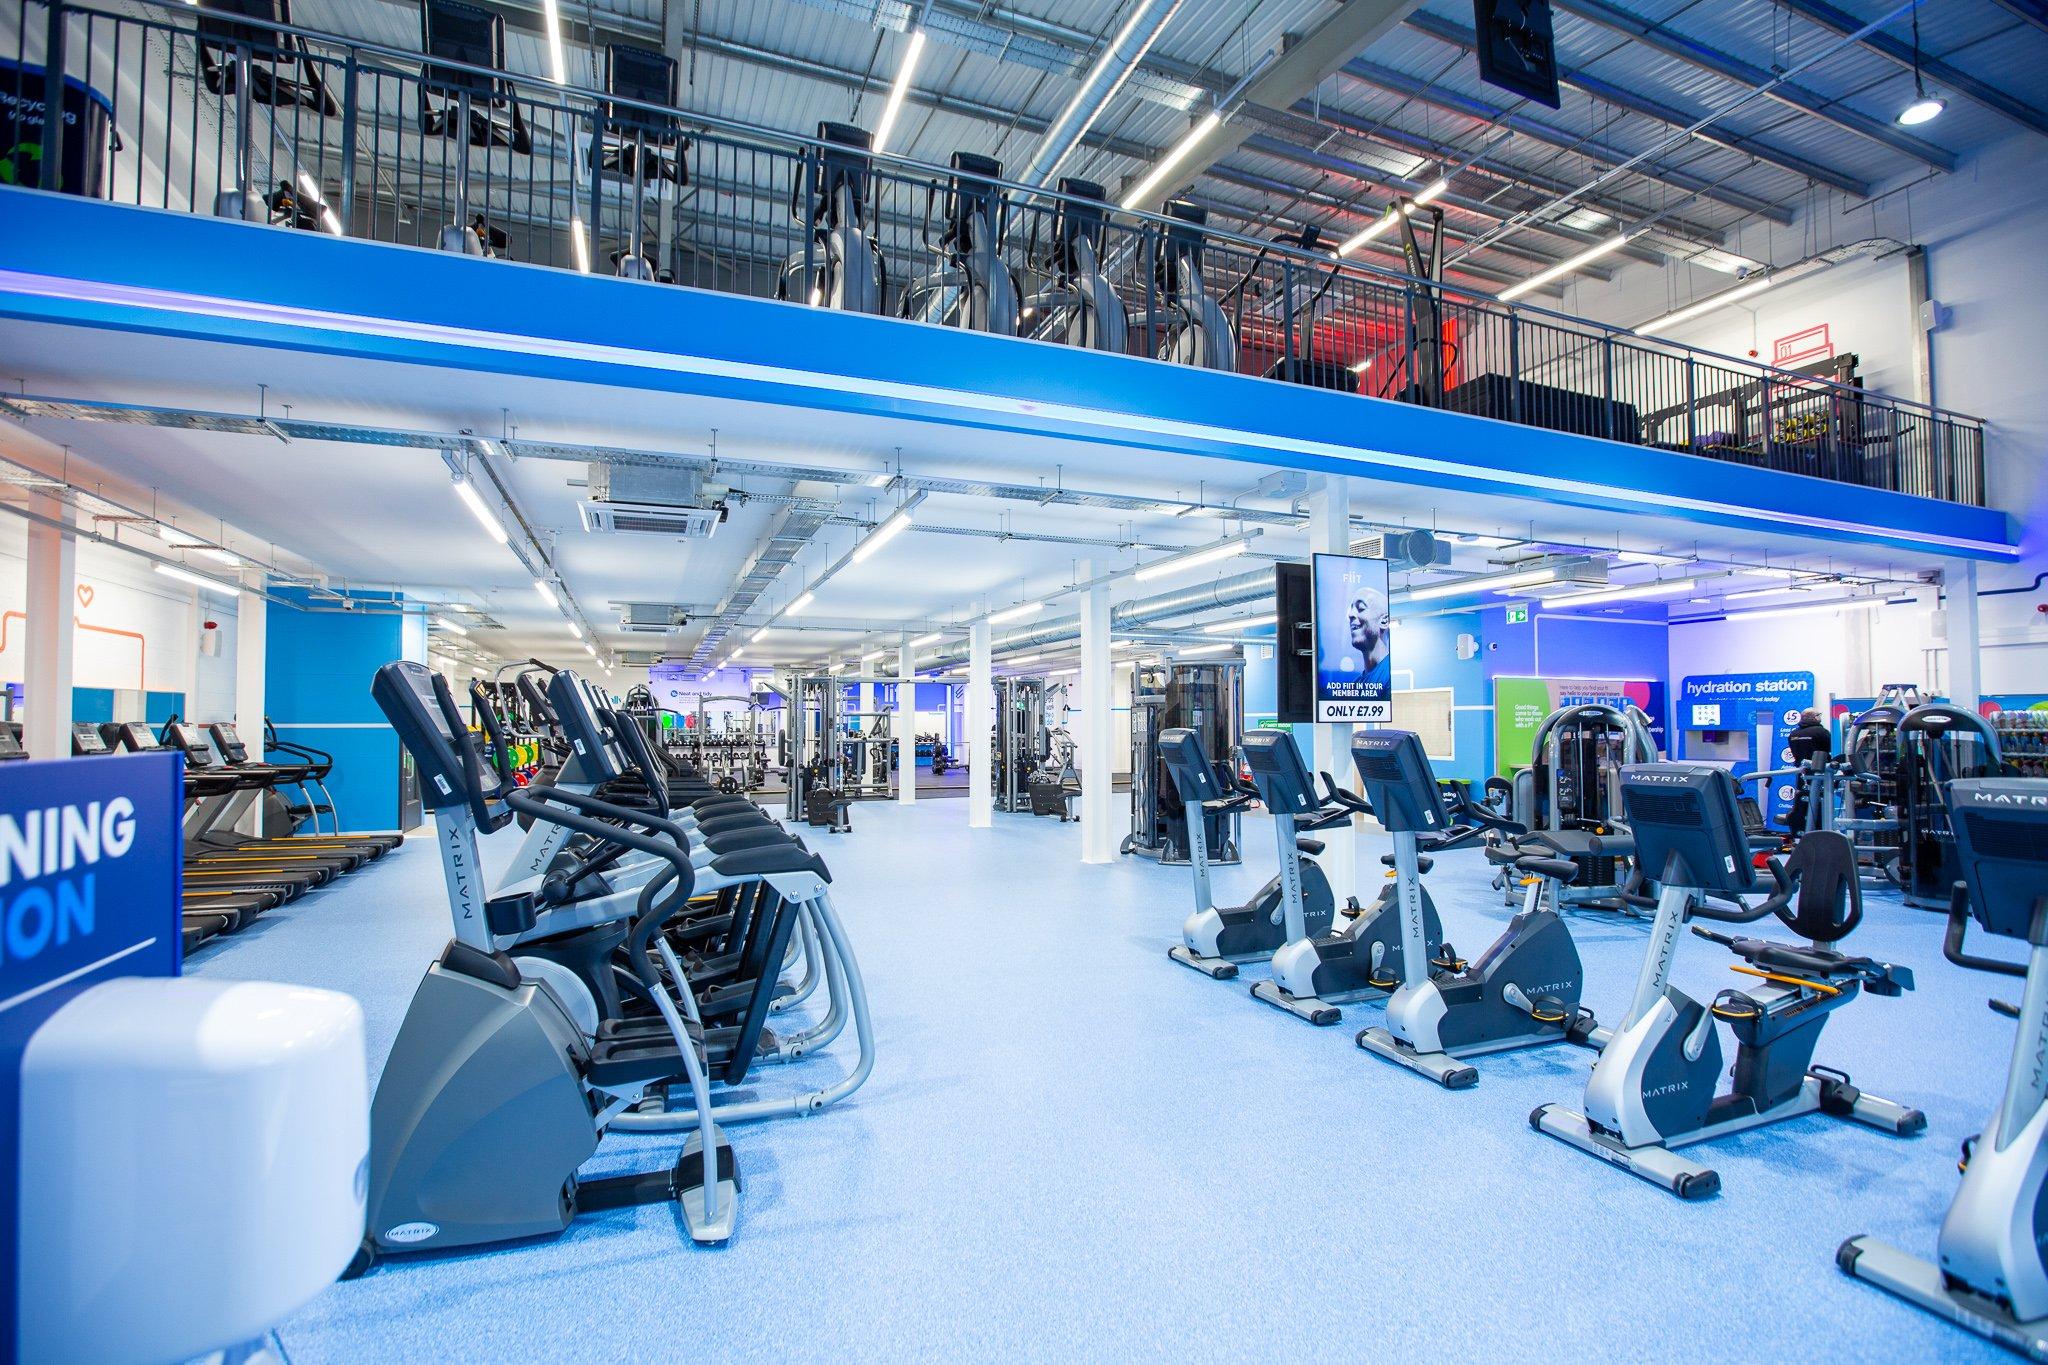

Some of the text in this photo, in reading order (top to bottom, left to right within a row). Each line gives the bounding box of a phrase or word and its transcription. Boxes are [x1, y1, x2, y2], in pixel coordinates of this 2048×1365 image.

[1326, 682, 1341, 690] ADD
[1343, 682, 1355, 690] FIIT
[1364, 682, 1383, 690] YOUR
[1332, 689, 1359, 697] MEMBER
[1686, 678, 1808, 698] hydration station
[1326, 705, 1384, 717] ONLY £7.99
[1244, 736, 1271, 744] MATRIX
[1356, 739, 1391, 747] MATRIX
[1631, 774, 1688, 784] MATRIX
[1974, 792, 2048, 806] MATR
[530, 806, 572, 872] MATRX
[1921, 828, 1954, 837] MATRI
[0, 796, 136, 888] NING
[1196, 833, 1205, 877] MATRIX
[449, 827, 473, 920] MATRIX
[1287, 852, 1298, 904] MATRIX
[1303, 909, 1327, 918] TRIX
[1408, 877, 1420, 939] MATRIX
[1652, 910, 1679, 988] MATRIX
[1526, 981, 1573, 995] MATRIX
[1642, 1081, 1689, 1100] MATRIX
[391, 1227, 432, 1238] MATRIX
